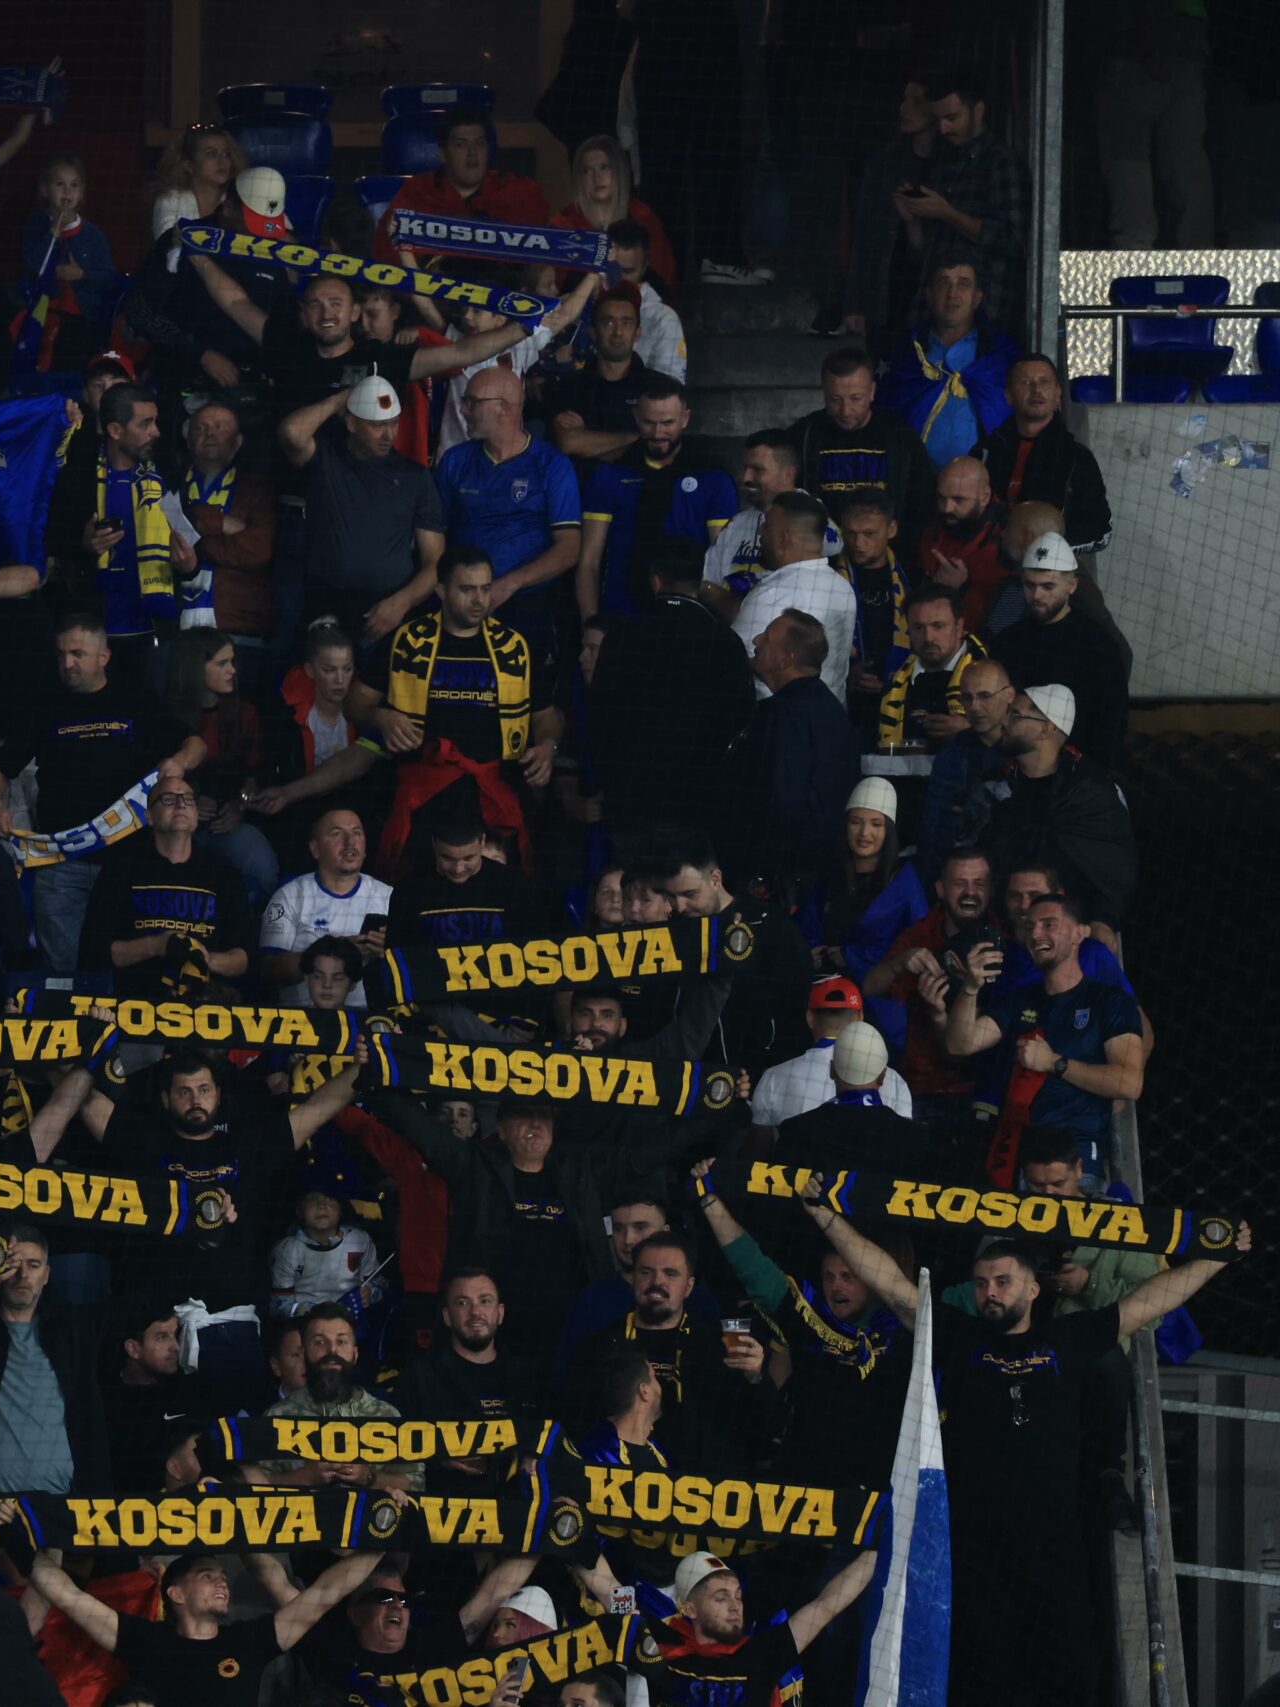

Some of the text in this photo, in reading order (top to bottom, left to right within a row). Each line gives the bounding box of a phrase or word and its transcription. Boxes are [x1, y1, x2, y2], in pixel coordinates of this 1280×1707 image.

[399, 217, 551, 250] KOSOVA
[438, 928, 682, 991] KOSOVA
[426, 1043, 660, 1106] KOSOVA
[887, 1181, 1149, 1244] KOSOVA
[273, 1419, 517, 1463] KOSOVA
[67, 1496, 321, 1546] KOSOVA
[585, 1466, 837, 1537] KOSOVA
